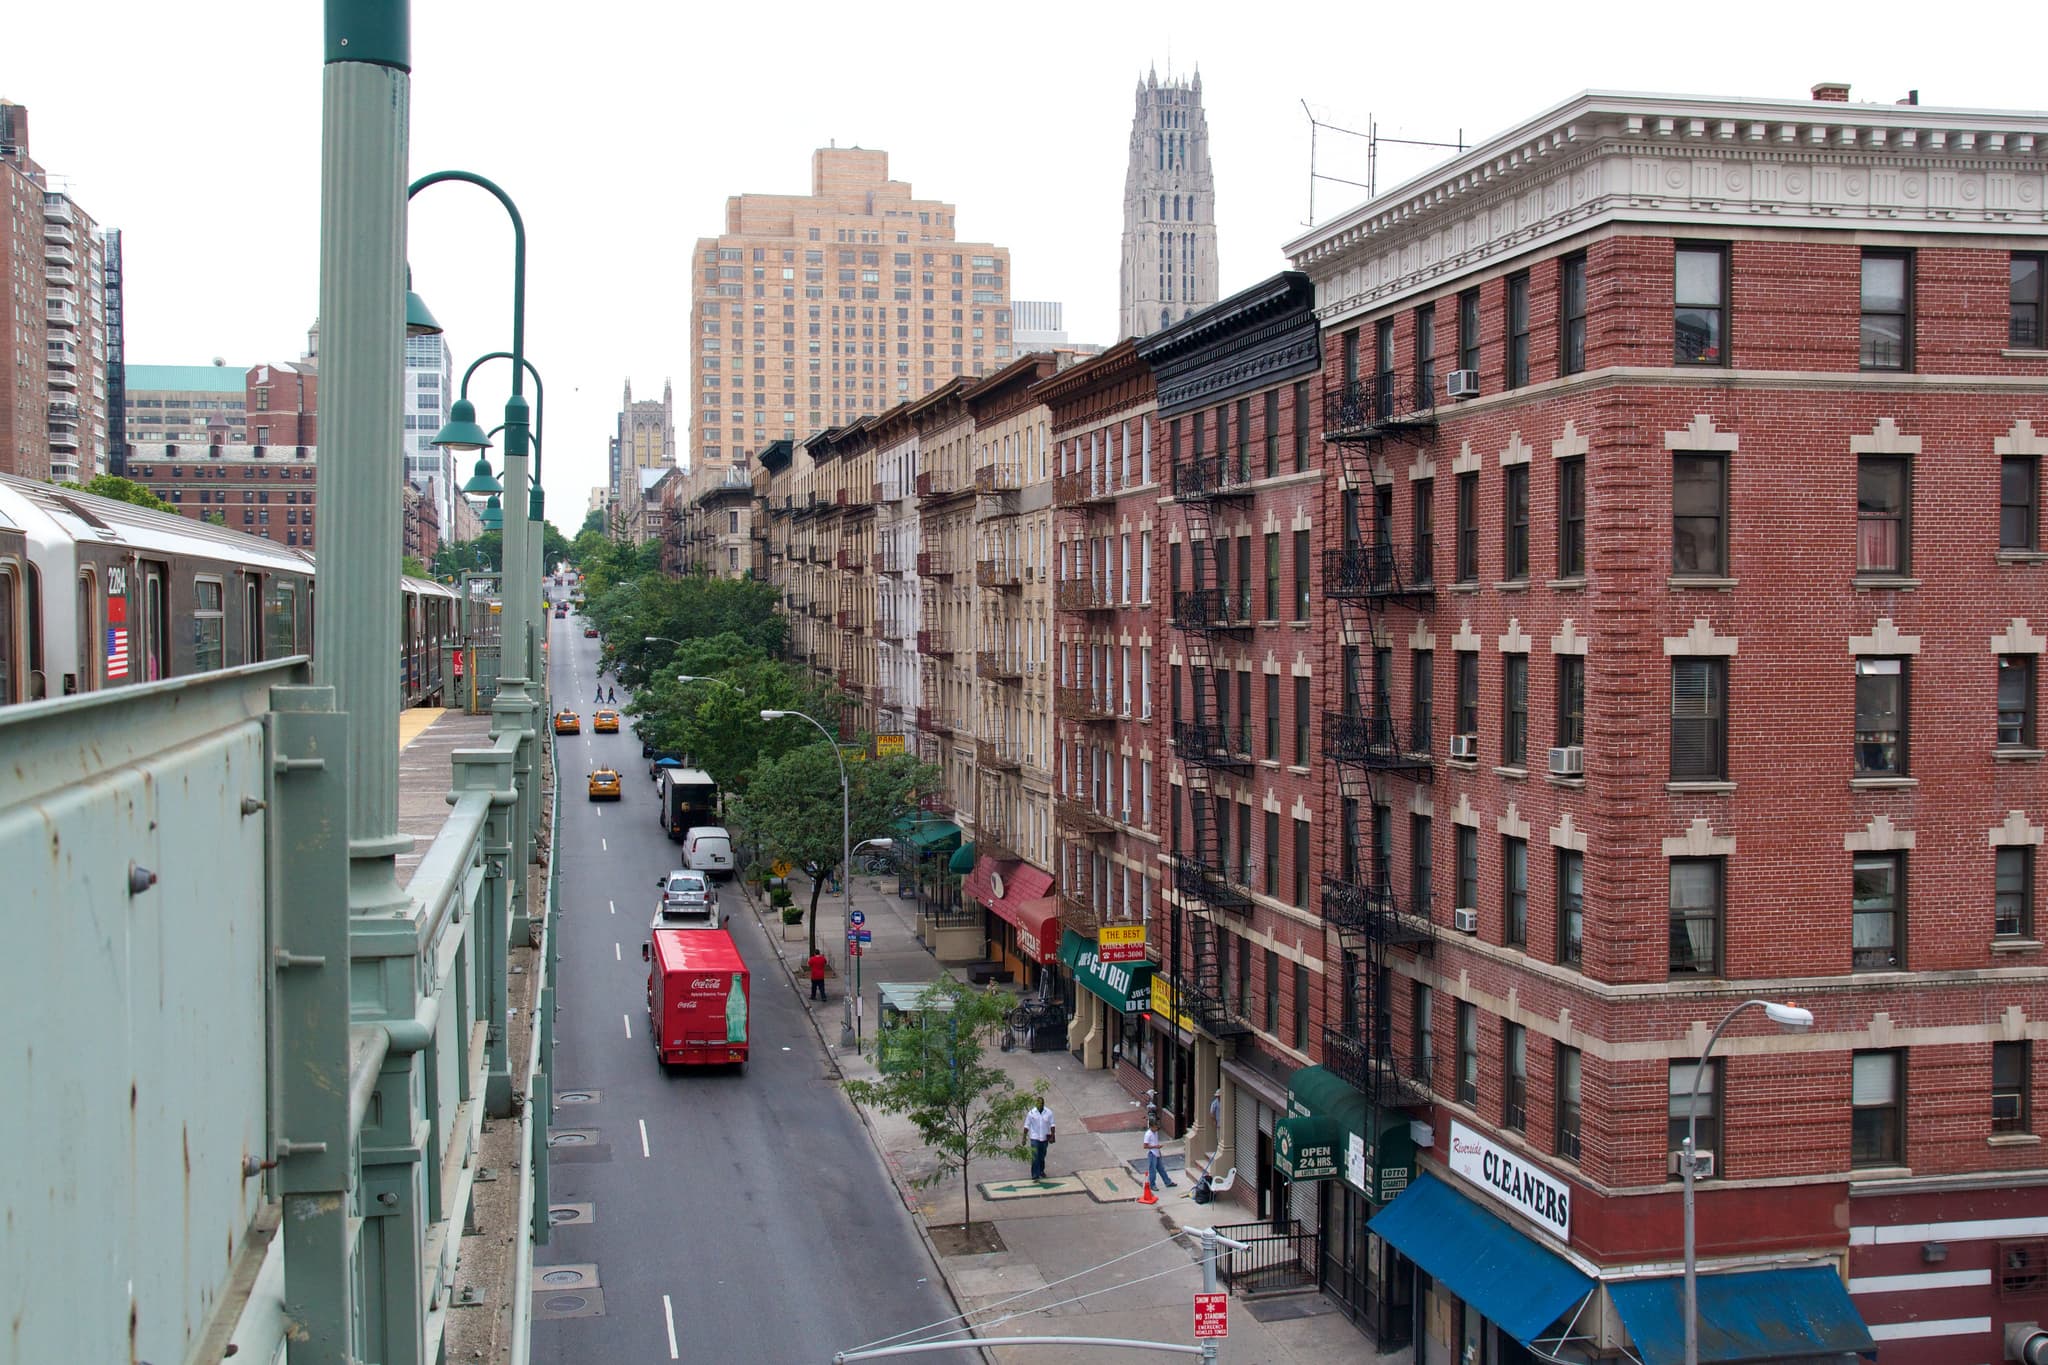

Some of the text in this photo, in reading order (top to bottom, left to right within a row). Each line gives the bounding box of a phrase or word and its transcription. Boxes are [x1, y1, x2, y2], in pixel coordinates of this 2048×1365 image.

[879, 736, 903, 744] PANDA
[1106, 929, 1140, 940] THE BEST
[1107, 964, 1130, 995] DELI
[1131, 986, 1151, 999] JOE'S
[1301, 1146, 1331, 1158] OPEN
[1299, 1157, 1316, 1169] 24
[1316, 1156, 1334, 1167] HRS.
[1383, 1169, 1406, 1177] LOTTO
[1453, 1136, 1568, 1228] Riverside CLEANERS
[1196, 1295, 1225, 1304] SNOW ROUTE
[1195, 1312, 1226, 1321] NO STANDING
